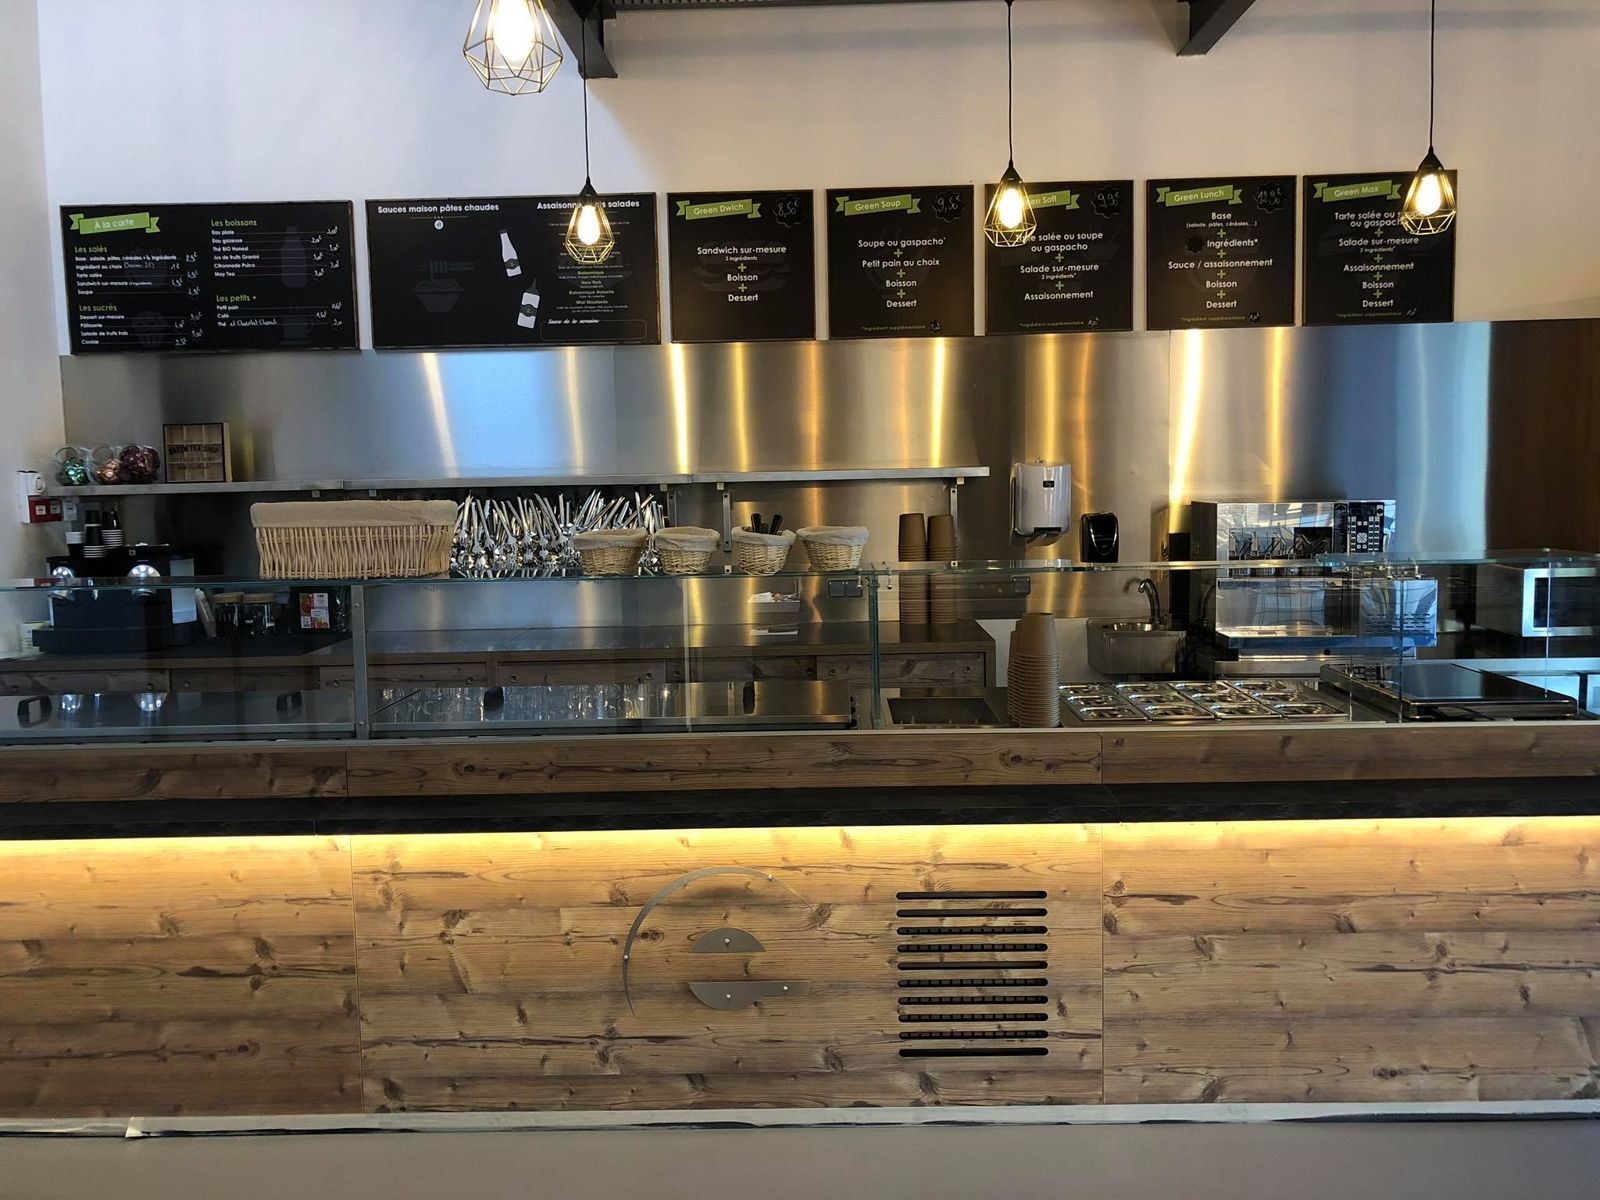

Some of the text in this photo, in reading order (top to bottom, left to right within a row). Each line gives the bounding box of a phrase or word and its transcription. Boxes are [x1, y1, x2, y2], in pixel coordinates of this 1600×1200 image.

[1333, 185, 1379, 198] Green Max
[1042, 195, 1057, 204] Soft
[1173, 190, 1225, 203] Green Lunch
[377, 203, 500, 214] Sauces maison pâtes chaudes
[608, 200, 640, 209] salades
[854, 199, 901, 212] Green Soup
[693, 203, 744, 216] Green Dwich
[1211, 212, 1232, 220] Base
[1334, 212, 1356, 220] Tarte
[1357, 210, 1382, 219] salée
[112, 219, 135, 228] carte
[211, 219, 257, 227] Les boissons
[1350, 219, 1362, 228] ou
[1038, 232, 1062, 241] salée
[1063, 233, 1075, 241] ou
[1077, 232, 1104, 242] soupe
[858, 239, 885, 249] Soupe
[1338, 237, 1420, 247] Salade sur-mesure
[88, 244, 108, 253] salés
[697, 246, 787, 255] Sandwich sur-mesure
[1031, 243, 1089, 254] ou gaspacho
[862, 260, 881, 268] Petit
[881, 259, 902, 269] pain
[916, 257, 941, 267] choix
[1168, 261, 1195, 269] Sauce
[1203, 259, 1273, 268] assaisonnement
[1343, 262, 1415, 272] Assaisonnement
[1020, 264, 1100, 274] Salade sur-mesure
[727, 273, 759, 282] Boisson
[885, 280, 917, 288] Boisson
[1205, 280, 1238, 289] Boisson
[1362, 281, 1395, 290] Boisson
[216, 294, 229, 302] Les
[230, 294, 251, 303] petits
[728, 293, 759, 302] Dessert
[1024, 291, 1094, 301] Assaisonnement
[79, 303, 118, 312] Les sucrés
[886, 300, 917, 308] Dessert
[1206, 300, 1238, 309] Dessert
[1362, 299, 1394, 308] Dessert
